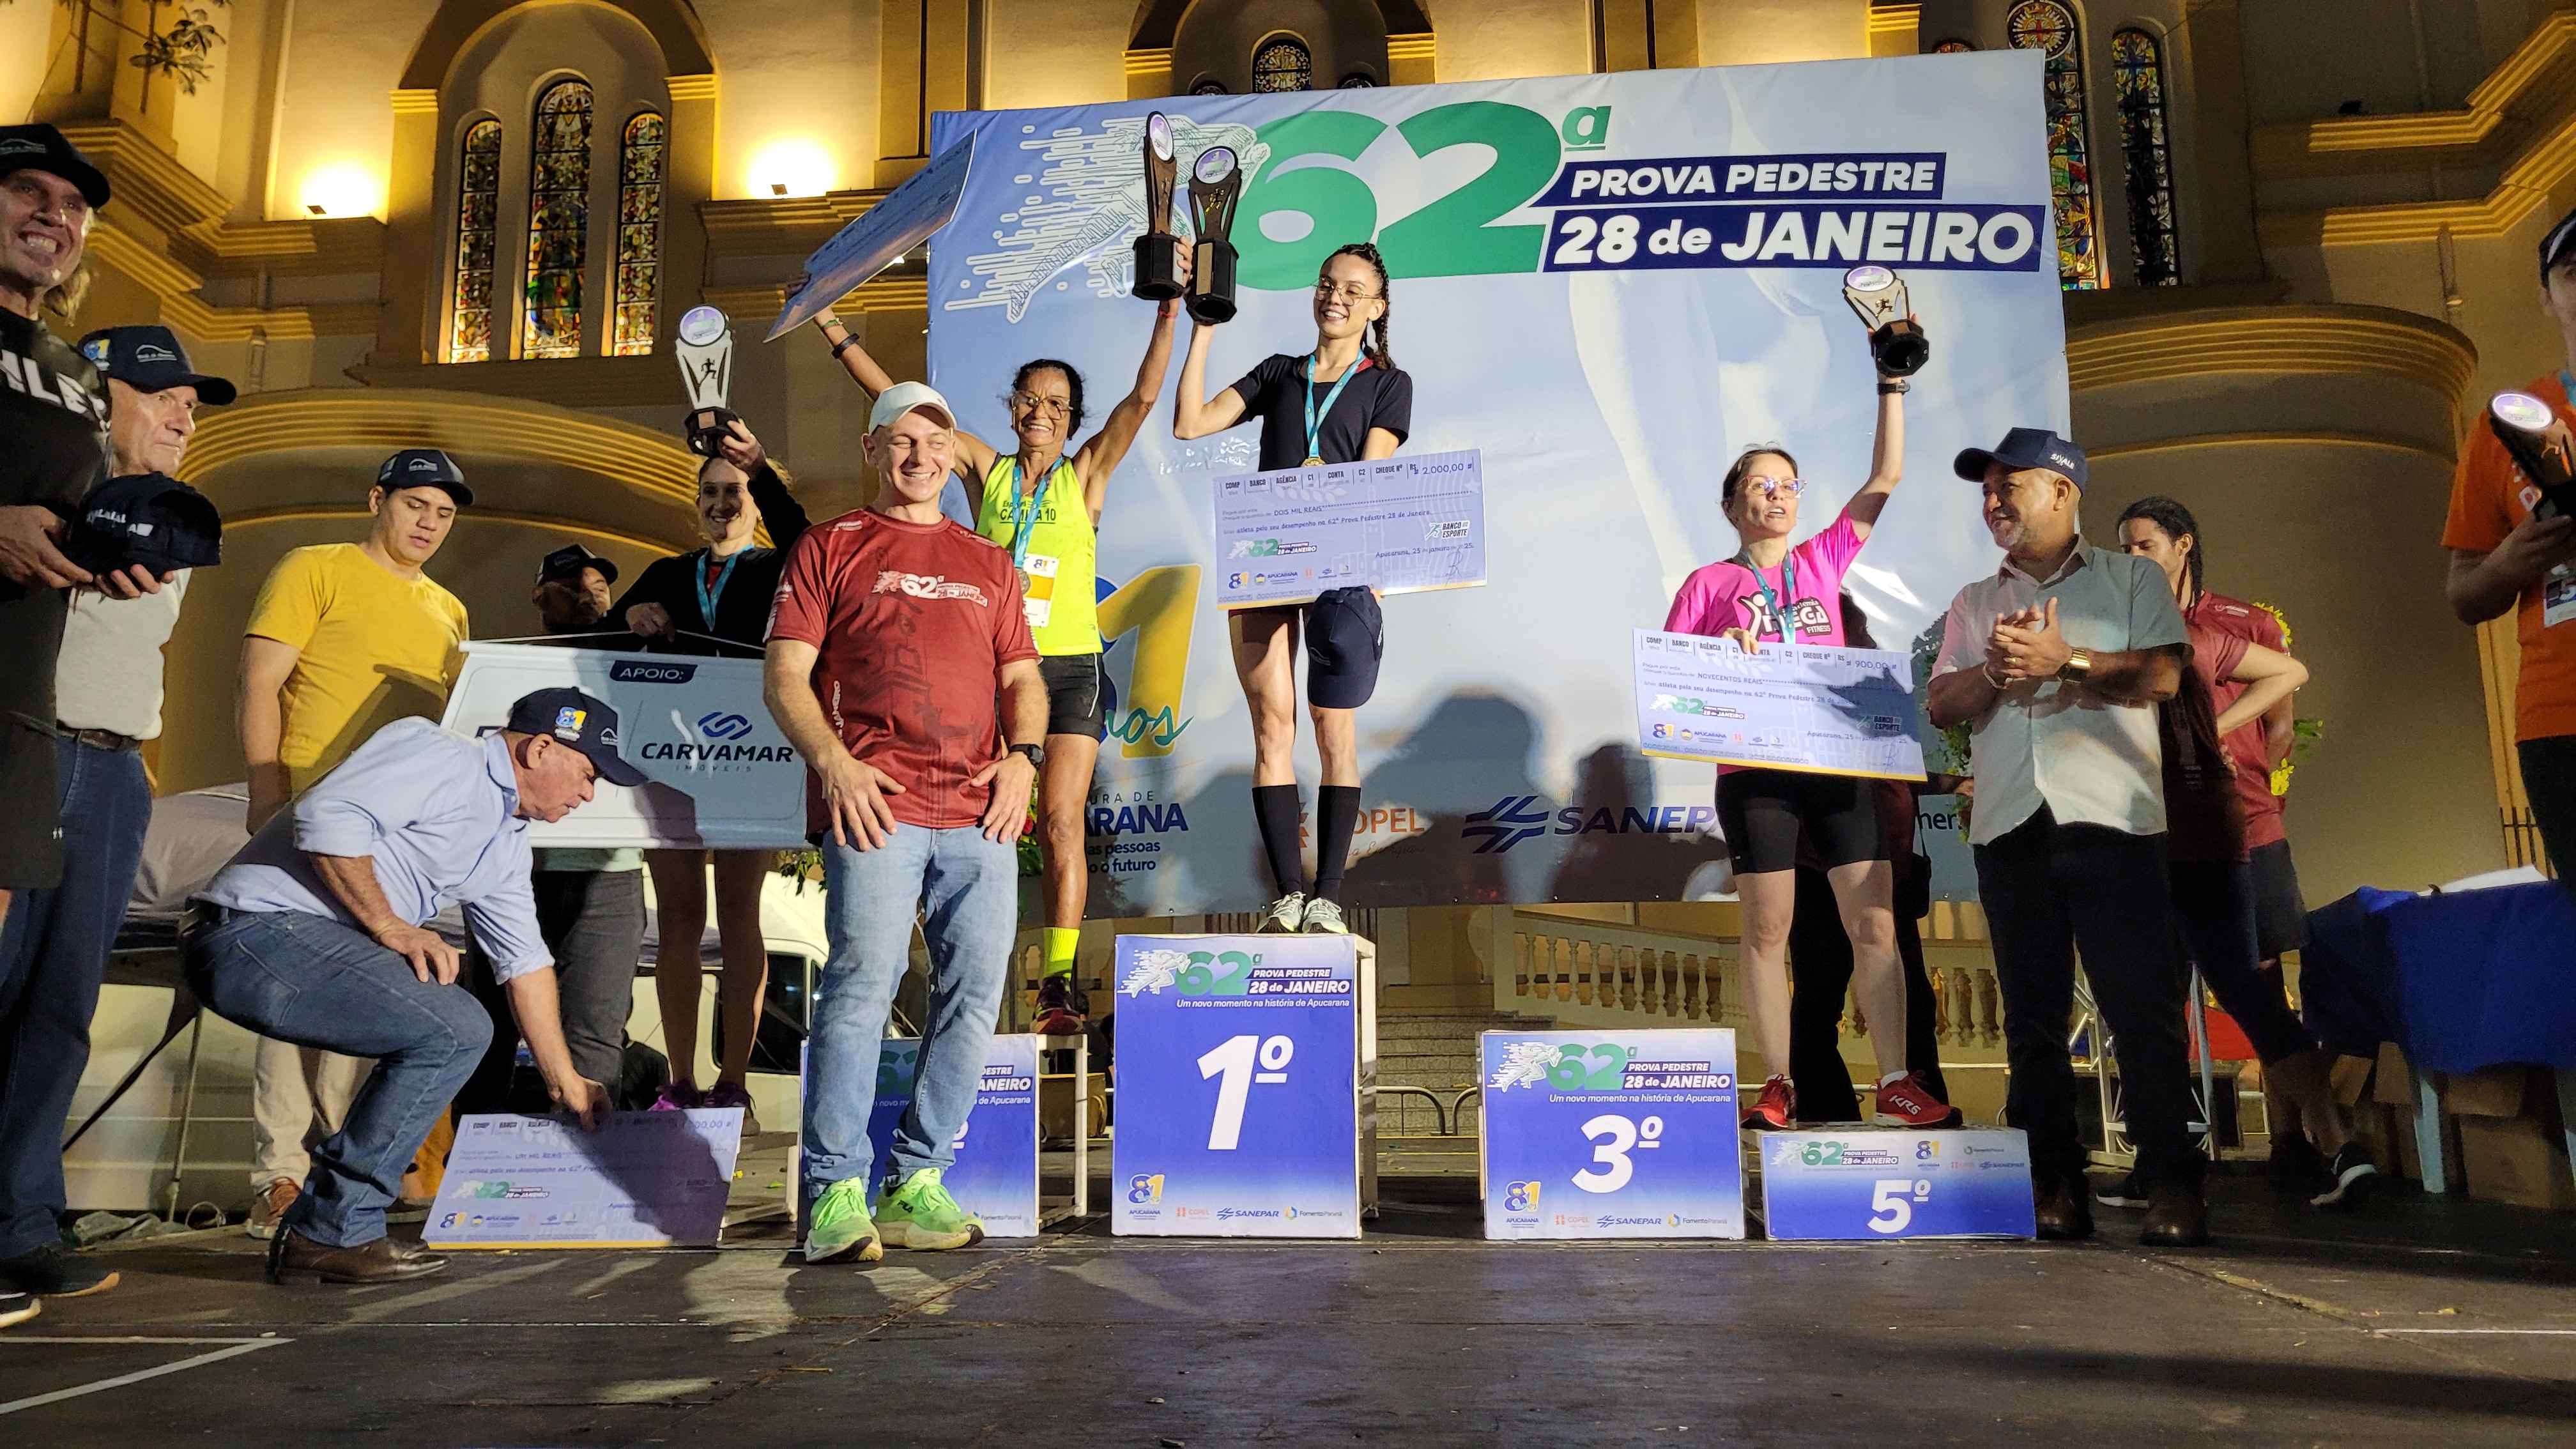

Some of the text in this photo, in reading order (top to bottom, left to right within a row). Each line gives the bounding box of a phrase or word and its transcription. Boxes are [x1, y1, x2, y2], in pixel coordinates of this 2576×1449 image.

[1571, 162, 1937, 197] PROVA PEDESTRE
[1232, 100, 1612, 291] 62ª
[1553, 211, 2035, 264] 28 de JANEIRO
[1276, 475, 1296, 484] AGÊNCIA
[1376, 465, 1395, 474] CHEQUE
[1423, 463, 1464, 475] 2.000,00
[1045, 509, 1055, 521] 10
[1282, 521, 1316, 530] desempenho
[1443, 522, 1461, 530] BANCO
[1443, 529, 1468, 538] ESPORTE
[1700, 642, 1721, 651] AGÊNCIA
[1855, 661, 1888, 670] 900,00
[619, 668, 684, 680] APOIO:
[1698, 673, 1741, 682] NOVECENTOS
[1706, 687, 1742, 695] desempenho
[641, 743, 793, 763] CARVAMAR
[1133, 791, 1154, 802] DE
[1354, 808, 1425, 834] OPEL
[1554, 807, 1715, 835] SANEP
[1105, 842, 1160, 858] pessoas
[1112, 859, 1156, 872] futuro
[1176, 951, 1263, 996] 62ª
[1254, 969, 1330, 978] PROVA PEDESTRE
[1249, 981, 1350, 993] 28 de JANEIRO
[1177, 999, 1190, 1008] Um
[1214, 999, 1252, 1008] momento
[1264, 999, 1294, 1007] história
[1307, 999, 1350, 1008] Apucarana
[983, 1066, 1013, 1075] DESTRE
[1547, 1043, 1637, 1091] 62ª
[1628, 1063, 1708, 1071] PROVA PEDESTRE
[979, 1078, 1031, 1091] ANEIRO
[1625, 1076, 1731, 1089] 28 de JANEIRO
[1197, 1035, 1294, 1150] 1º
[1549, 1094, 1564, 1103] Um
[1641, 1094, 1671, 1103] história
[1673, 1094, 1683, 1103] de
[1685, 1094, 1731, 1103] Apucarana
[991, 1097, 1031, 1105] Apucarana
[1571, 1114, 1663, 1193] 3º
[1128, 1174, 1165, 1204] 81
[1504, 1181, 1541, 1212] 81
[898, 1200, 914, 1213] FILA
[1867, 1179, 1931, 1234] 5º
